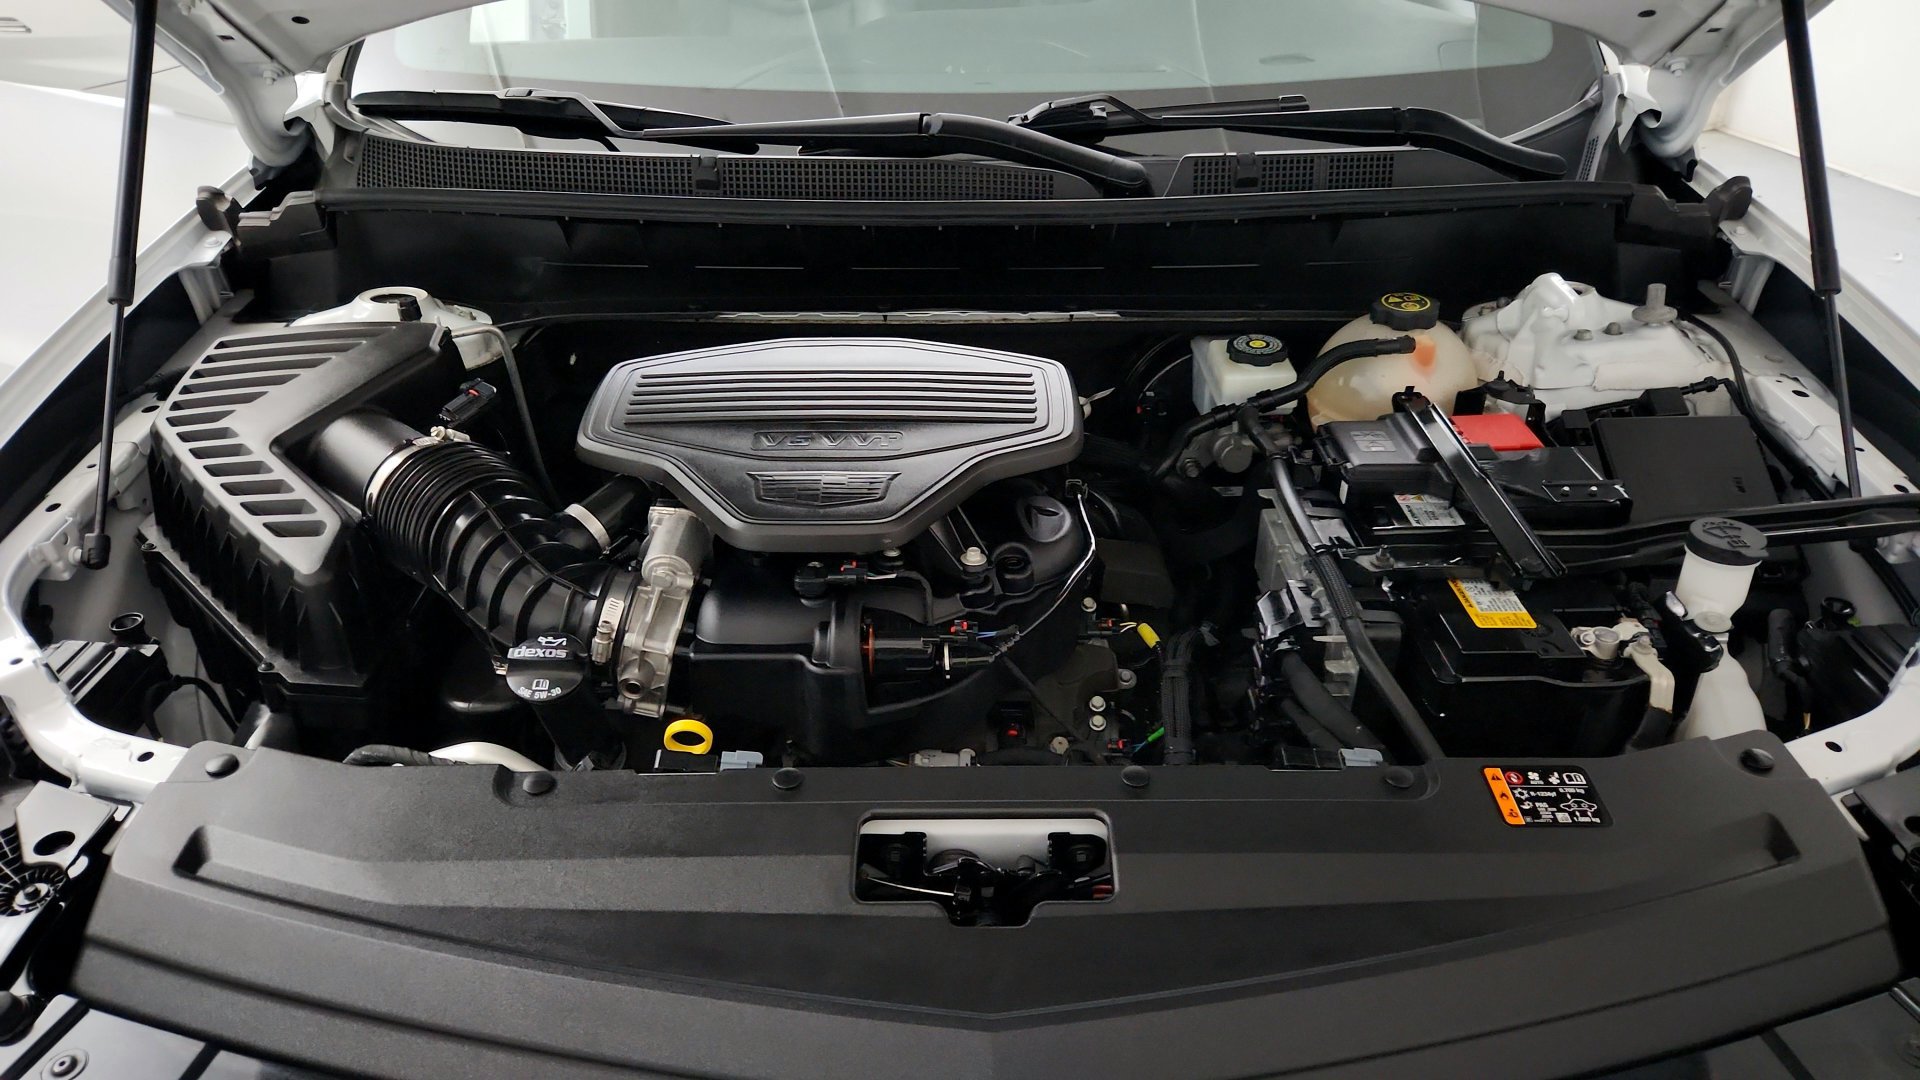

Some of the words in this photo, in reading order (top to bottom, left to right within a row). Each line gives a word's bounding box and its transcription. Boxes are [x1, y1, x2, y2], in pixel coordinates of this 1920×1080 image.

[513, 645, 569, 658] dexos
[517, 686, 533, 698] SAE
[534, 687, 562, 699] 5W-30
